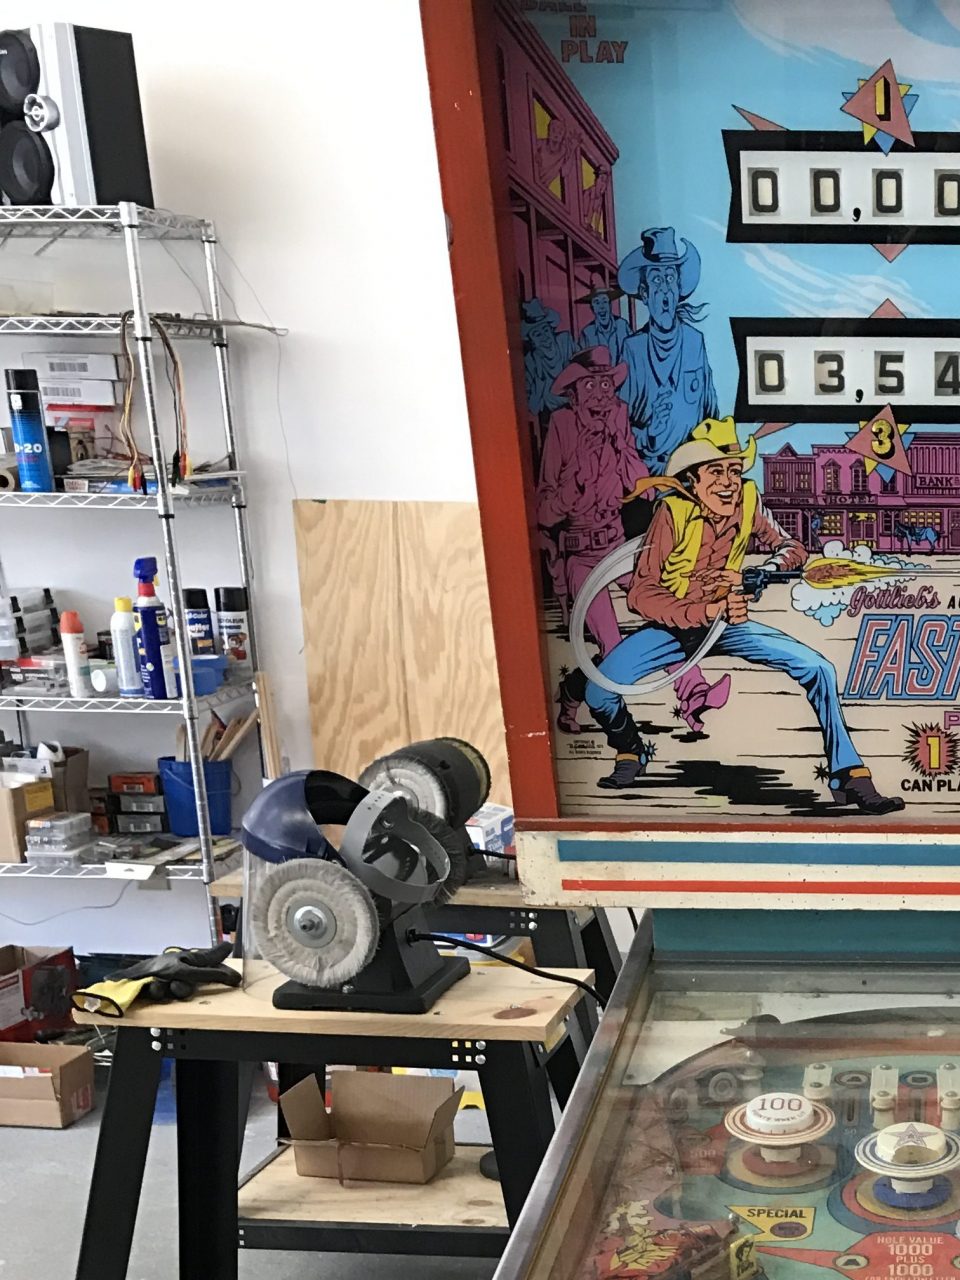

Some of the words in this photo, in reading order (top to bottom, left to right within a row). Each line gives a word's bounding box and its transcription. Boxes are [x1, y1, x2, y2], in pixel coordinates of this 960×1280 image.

[569, 15, 597, 38] IN
[560, 40, 629, 63] PLAY
[870, 418, 896, 460] 3
[918, 476, 954, 488] BANK
[847, 585, 942, 617] Gottlieb's
[947, 595, 956, 609] A
[925, 735, 942, 770] 1
[900, 779, 935, 793] CAN
[758, 1097, 803, 1112] 100
[746, 1208, 807, 1219] SPECIAL
[876, 1235, 906, 1244] HOLE
[909, 1236, 944, 1245] VALUE
[888, 1243, 933, 1256] 1000
[895, 1255, 926, 1263] PLUS
[888, 1263, 934, 1276] 1000
